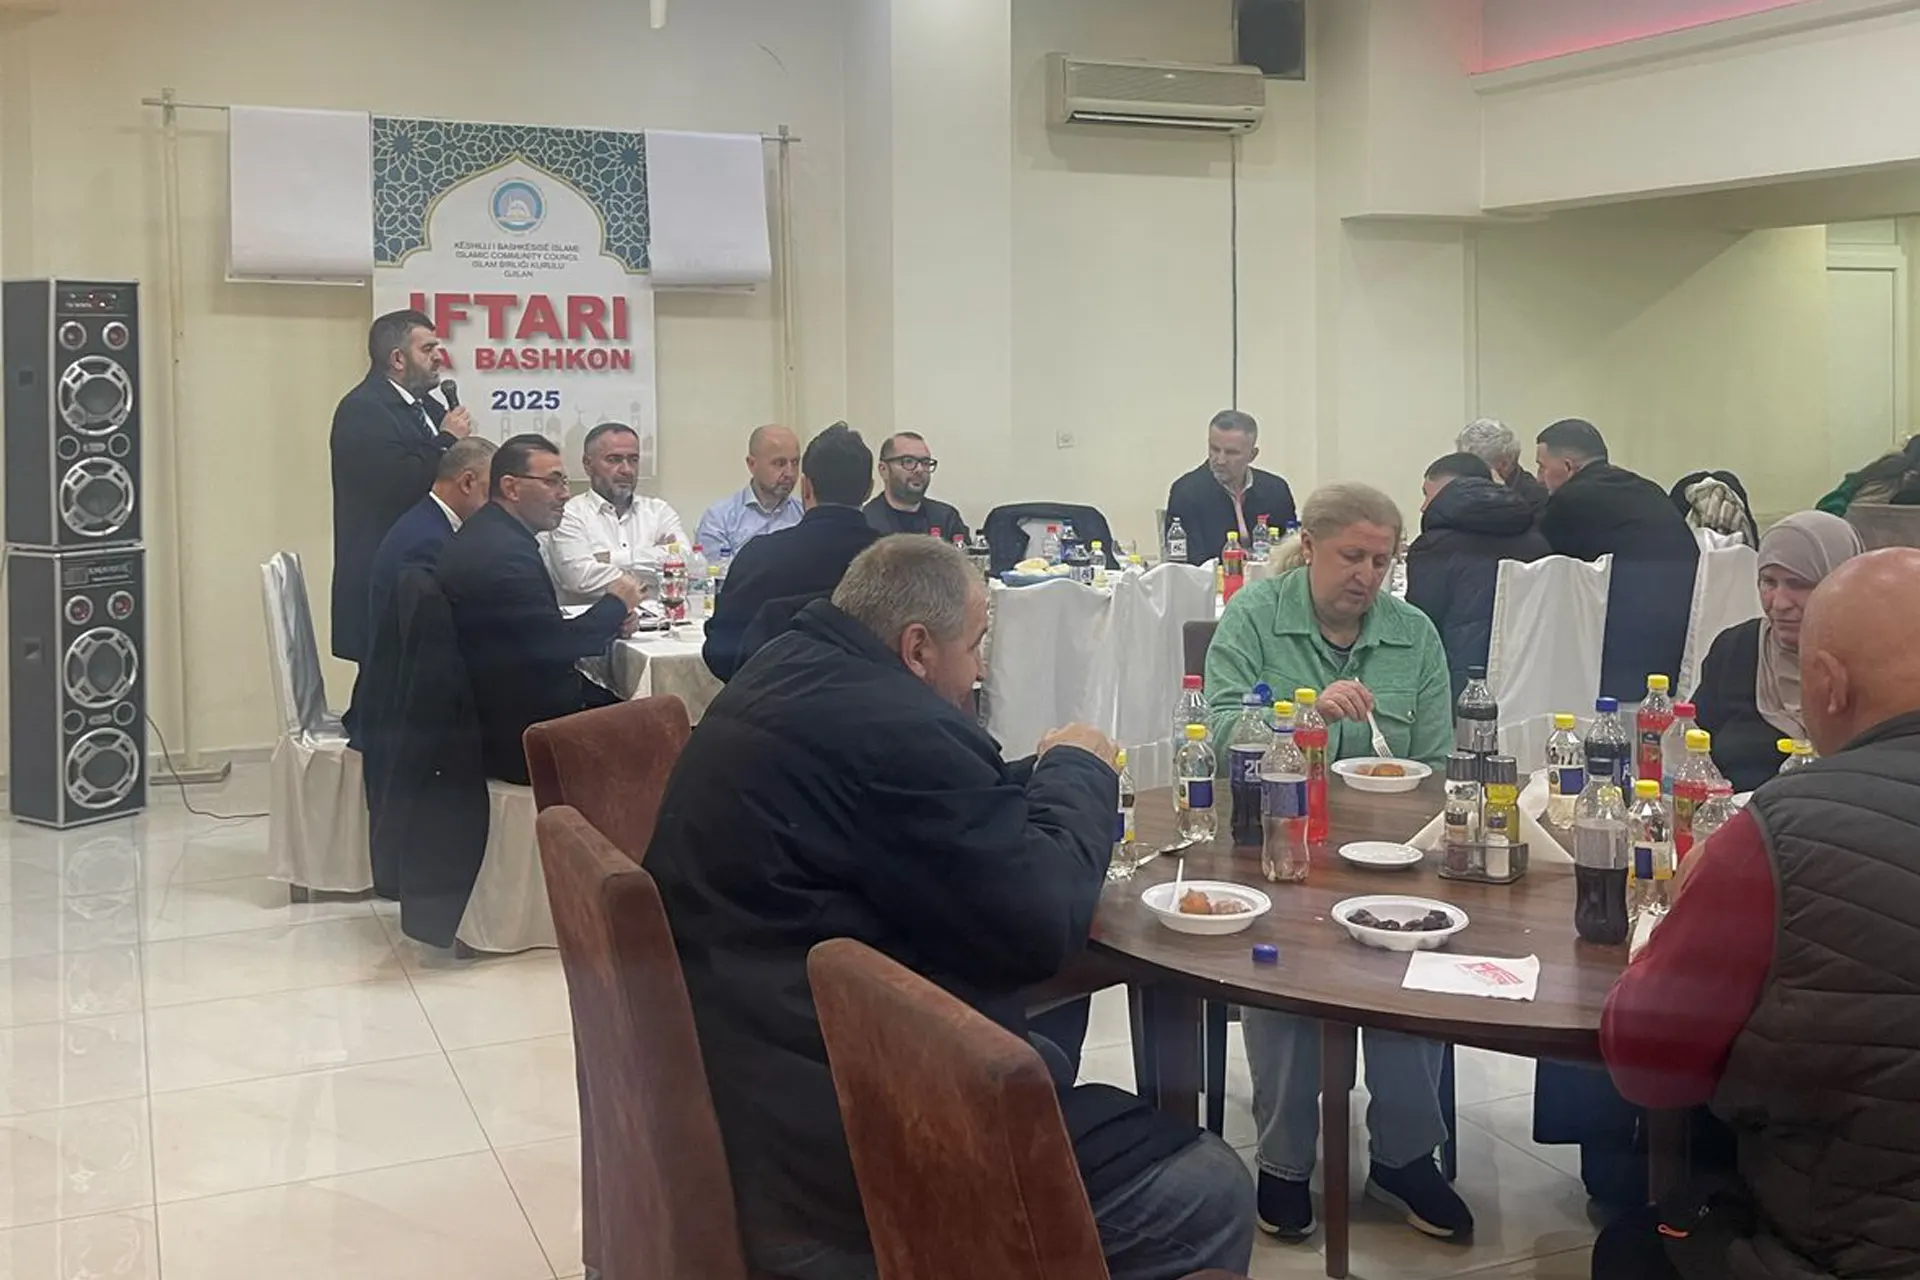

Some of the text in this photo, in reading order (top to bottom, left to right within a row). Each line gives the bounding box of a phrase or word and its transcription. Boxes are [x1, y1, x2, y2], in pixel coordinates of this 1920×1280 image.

[456, 251, 578, 261] ISLAMIC COMMUNITY COUNCIL
[475, 347, 632, 370] BASHKON
[491, 390, 560, 410] 2025
